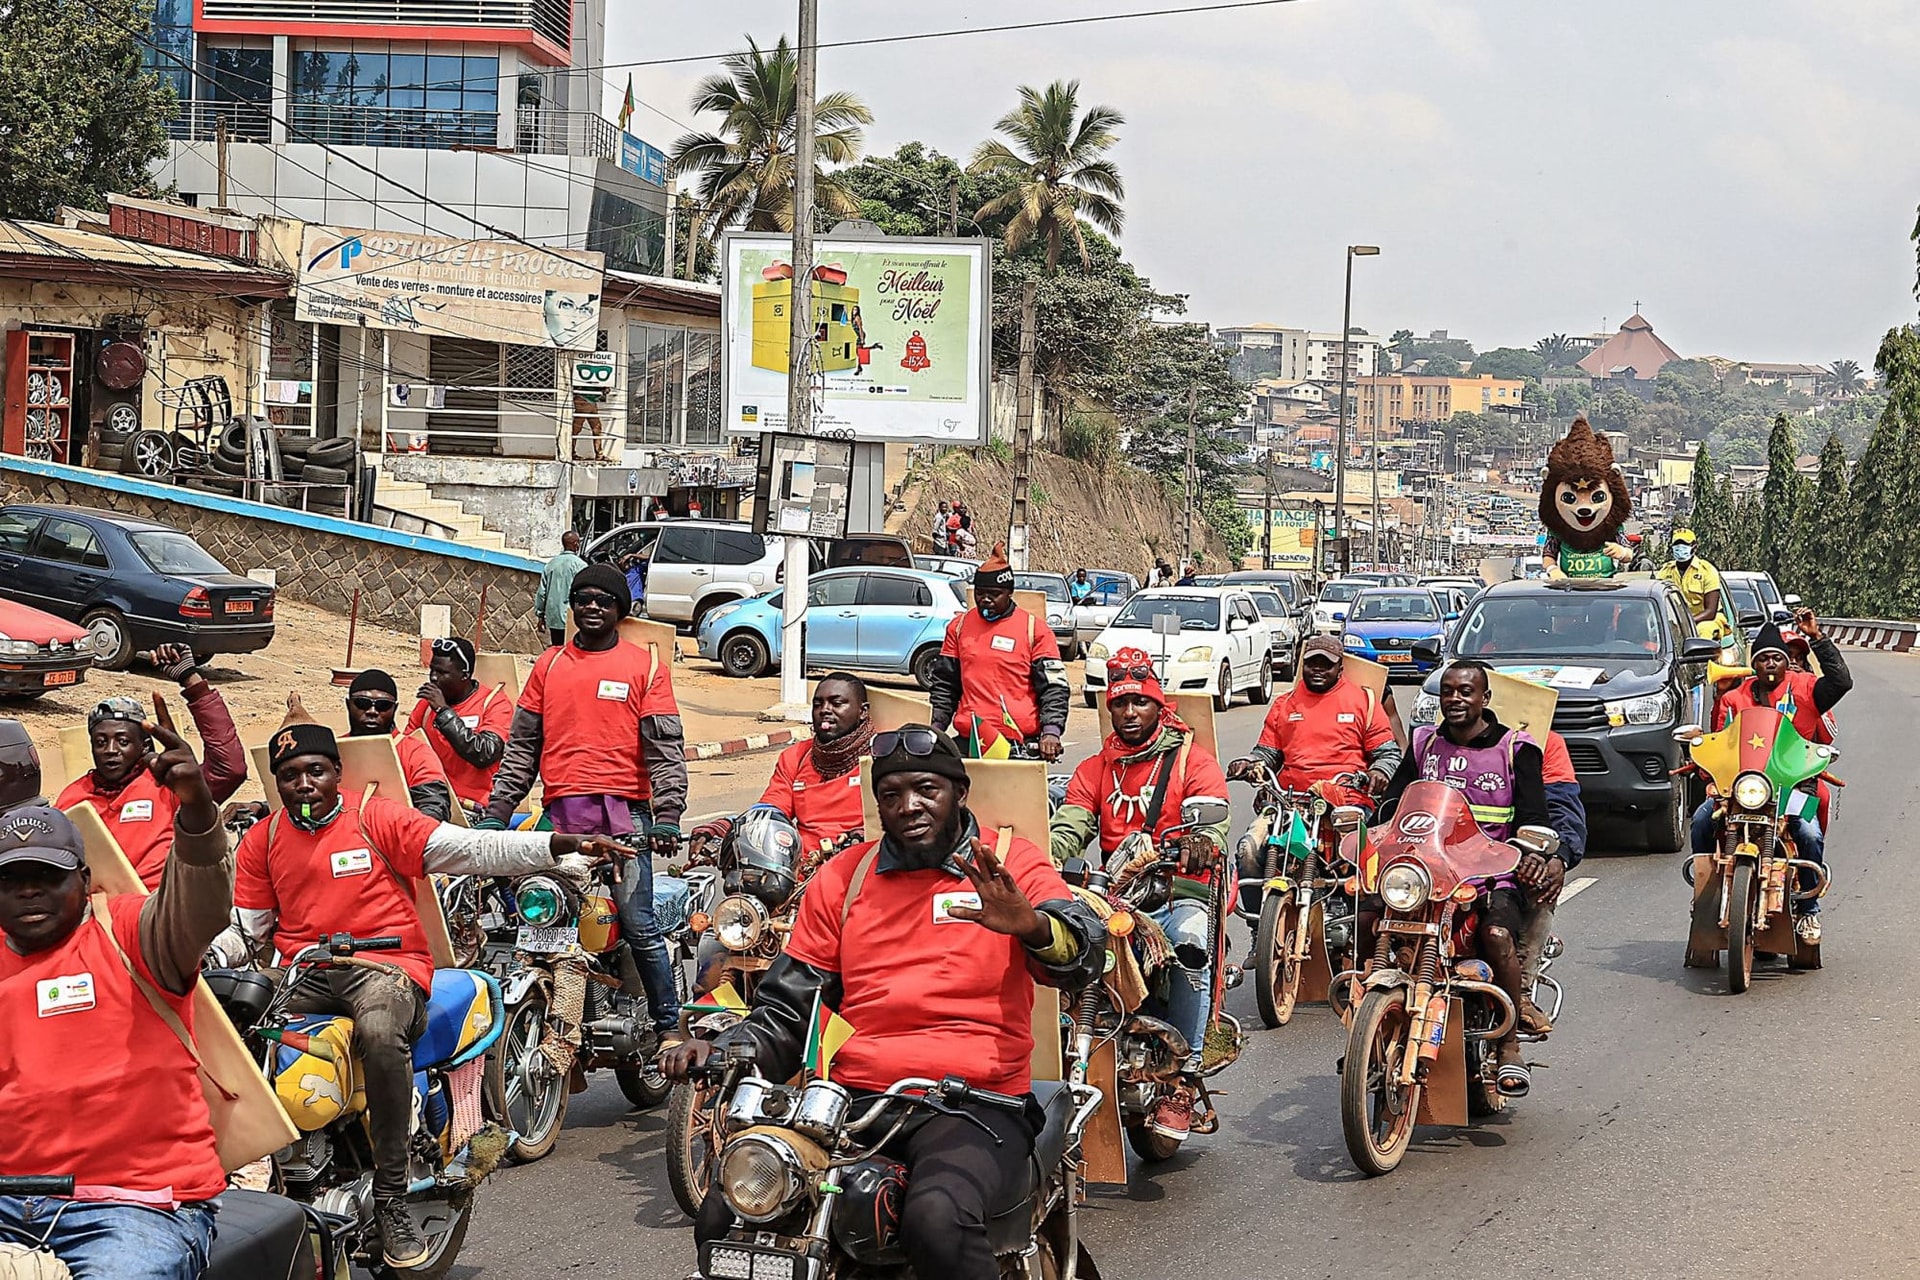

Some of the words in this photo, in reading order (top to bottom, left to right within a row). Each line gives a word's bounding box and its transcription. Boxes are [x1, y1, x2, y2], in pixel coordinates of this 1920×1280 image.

[366, 235, 467, 265] OPTIQUE
[470, 245, 496, 269] LE
[355, 274, 380, 287] Vente
[385, 277, 400, 290] des
[401, 281, 429, 292] verres
[436, 284, 474, 297] monture
[476, 288, 486, 299] et
[487, 290, 543, 305] accessoires
[877, 270, 944, 293] Meilleur
[892, 298, 941, 321] Noël
[1567, 558, 1602, 571] 2021
[1109, 682, 1143, 696] Supreme
[1447, 756, 1468, 772] 10
[1473, 772, 1506, 790] MOTOTAXI
[1396, 836, 1427, 844] LIFAN
